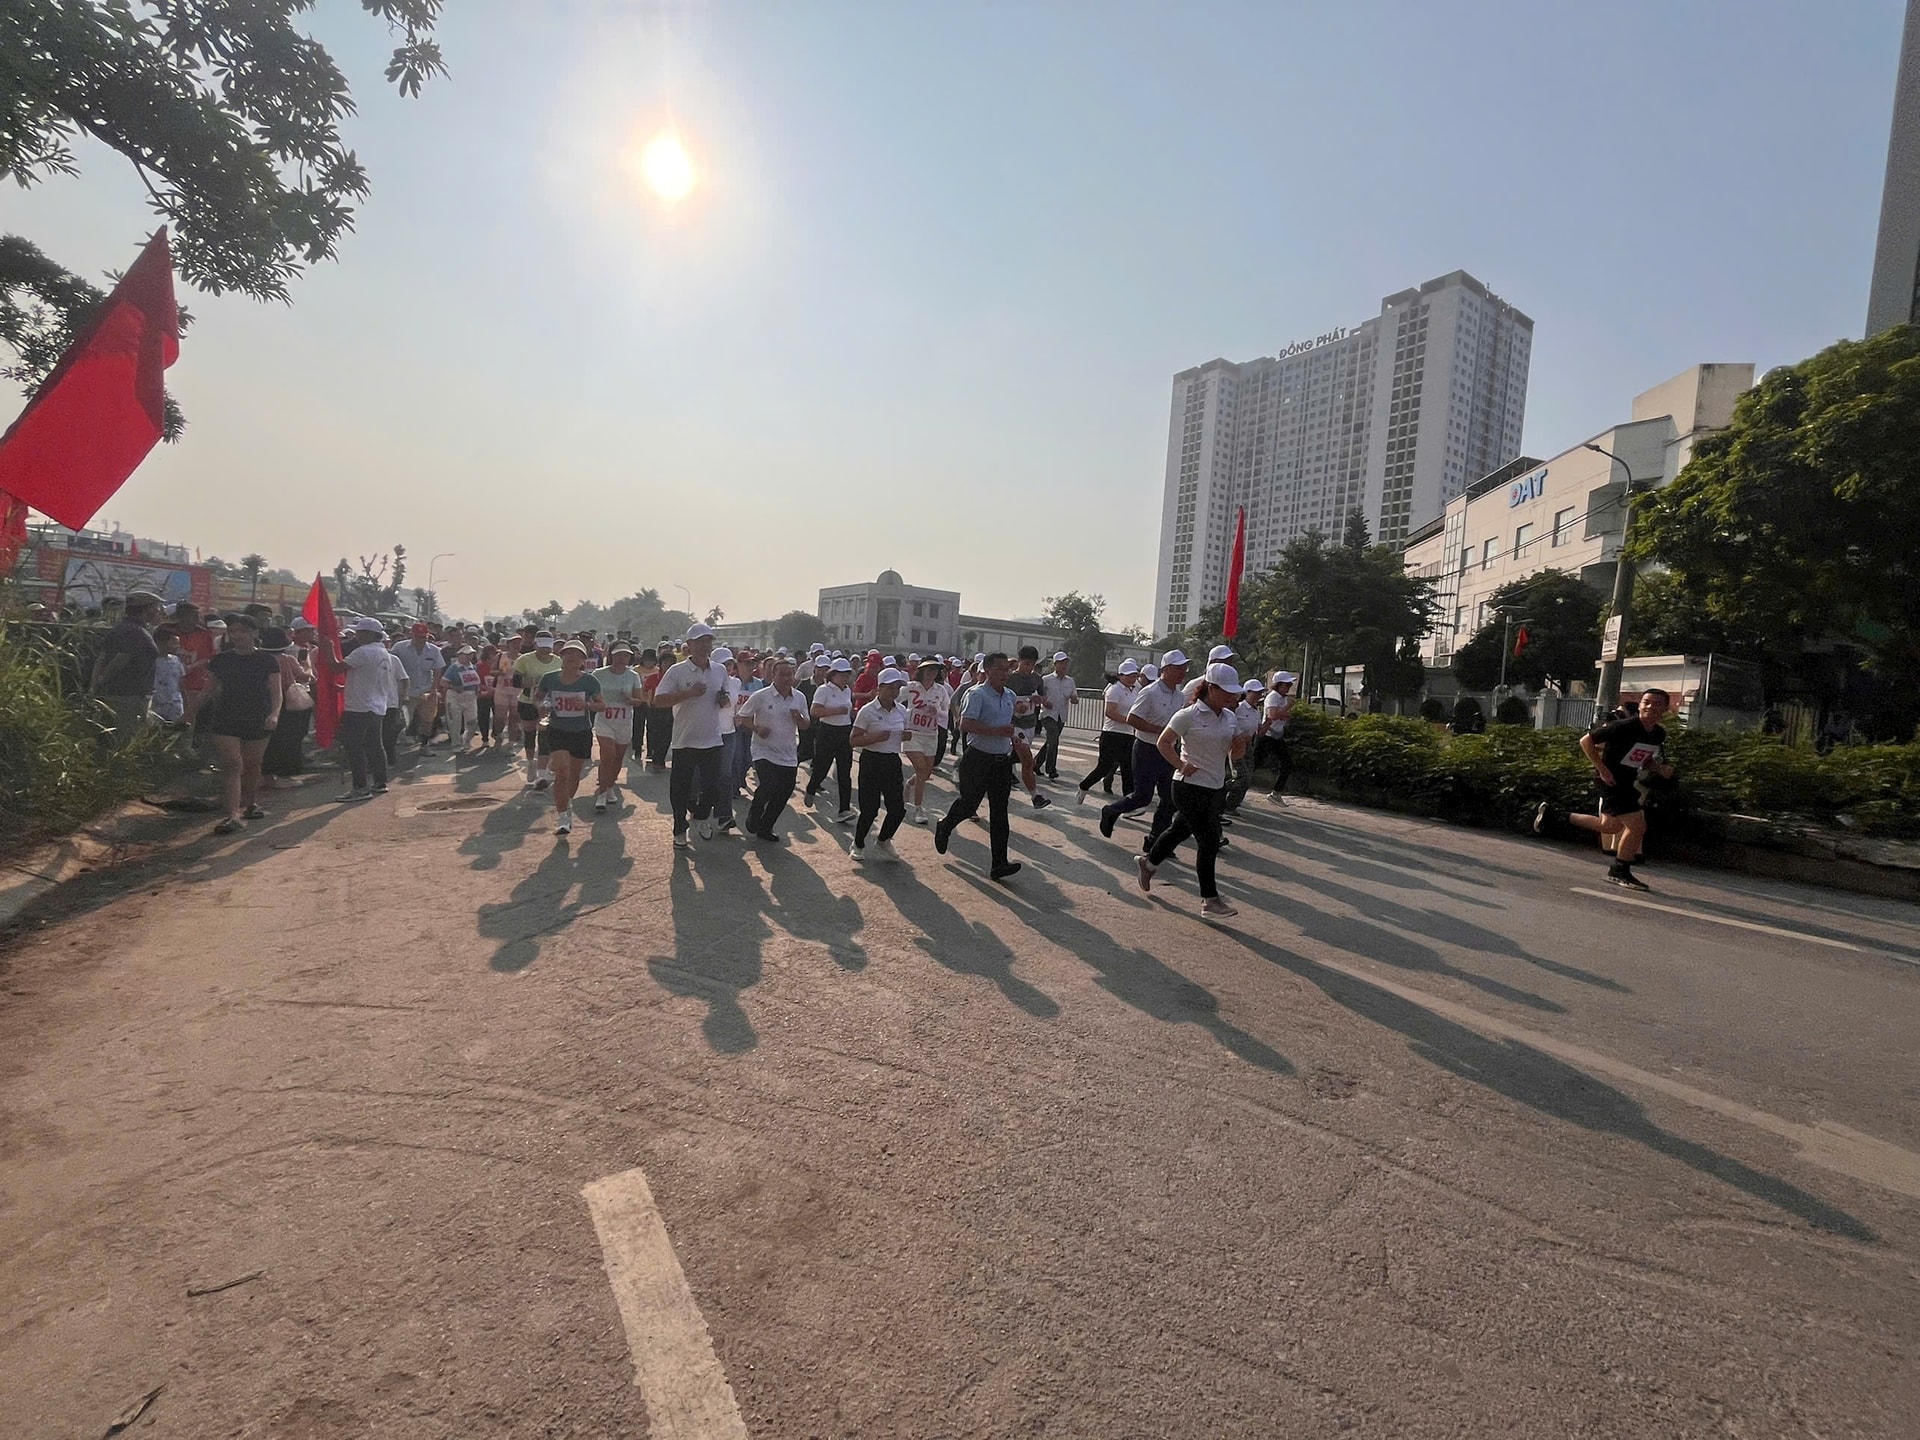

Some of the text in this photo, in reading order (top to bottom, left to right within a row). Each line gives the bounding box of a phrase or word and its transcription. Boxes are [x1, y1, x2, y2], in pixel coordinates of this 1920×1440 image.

[1316, 326, 1346, 346] PHÁT
[1510, 469, 1548, 508] DAT
[605, 707, 626, 719] 671
